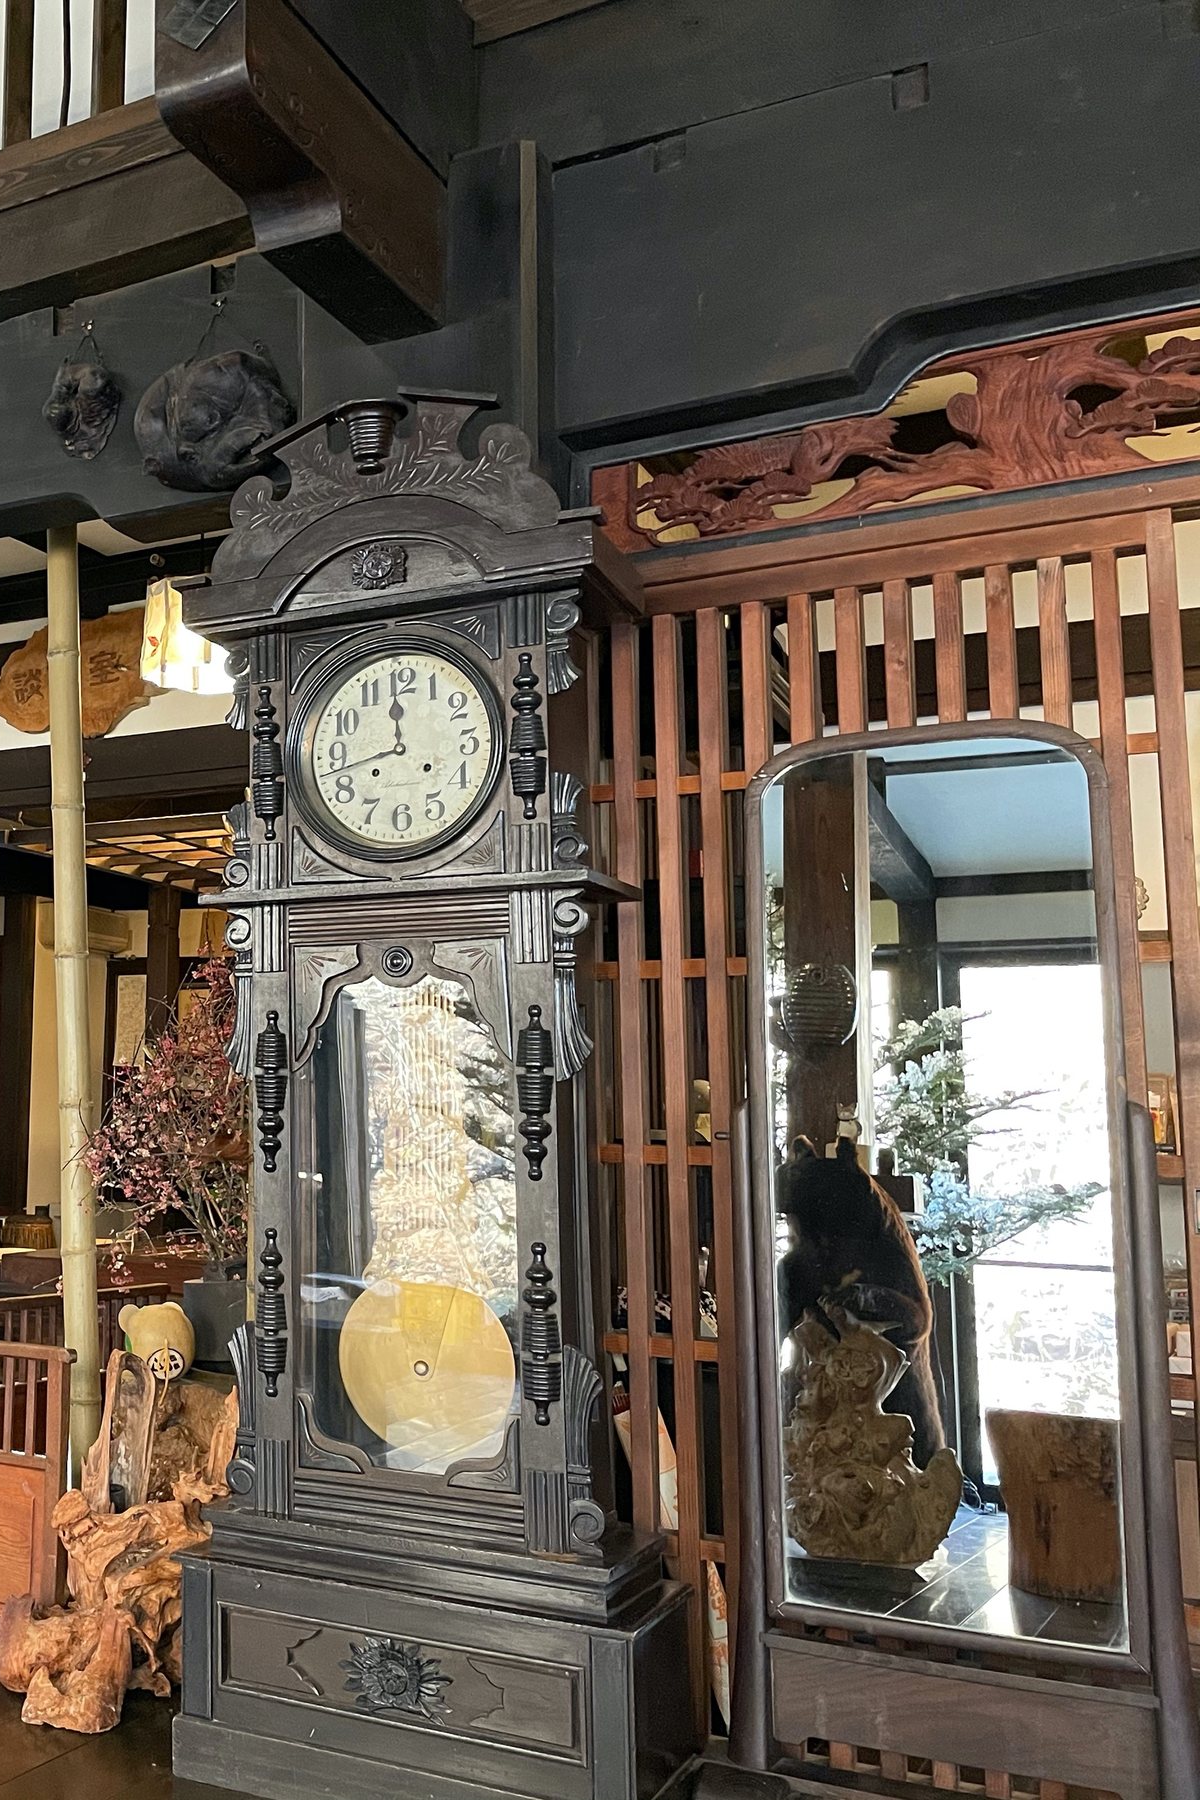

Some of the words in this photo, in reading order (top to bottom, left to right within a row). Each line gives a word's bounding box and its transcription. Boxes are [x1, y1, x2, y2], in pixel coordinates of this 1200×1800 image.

[12, 650, 122, 705] 談室
[388, 667, 417, 697] 12
[428, 672, 438, 701] 1
[360, 678, 381, 707] 11
[447, 691, 469, 722] 2
[335, 708, 360, 737] 10
[328, 741, 348, 771] 9
[459, 727, 480, 756] 3
[335, 775, 356, 804] 8
[447, 760, 472, 790] 4
[361, 797, 381, 825] 7
[391, 803, 413, 832] 6
[424, 789, 446, 821] 5
